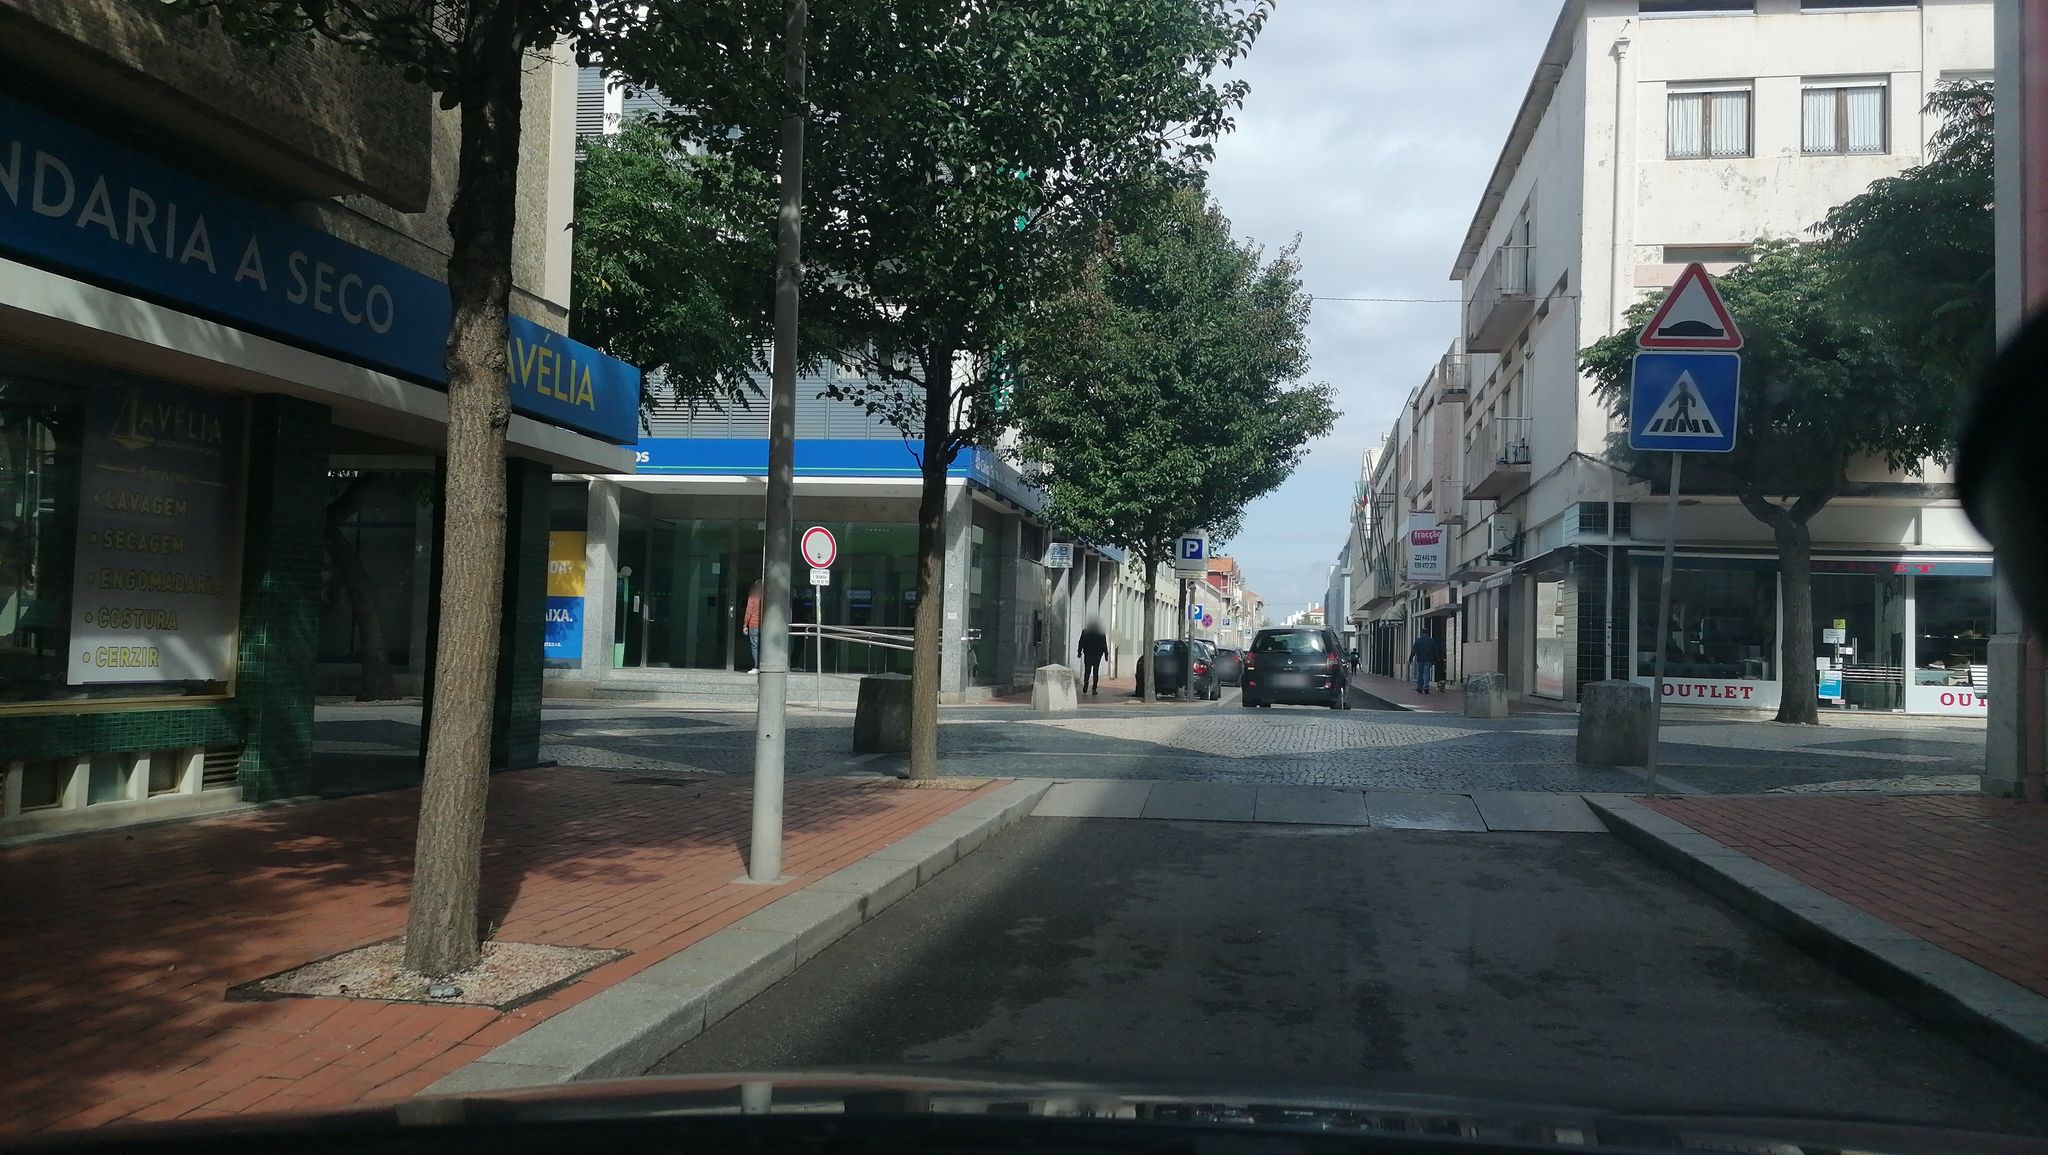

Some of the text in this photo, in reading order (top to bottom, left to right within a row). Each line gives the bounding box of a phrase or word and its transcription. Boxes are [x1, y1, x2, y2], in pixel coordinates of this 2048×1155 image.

[234, 232, 268, 292] A
[286, 250, 394, 334] SECO
[105, 489, 188, 517] LAVAGEM
[102, 529, 185, 555] SECAGEM
[1185, 540, 1199, 558] P
[97, 607, 178, 631] COSTURA
[95, 646, 160, 668] CERZIR
[1662, 683, 1754, 699] OUTLET
